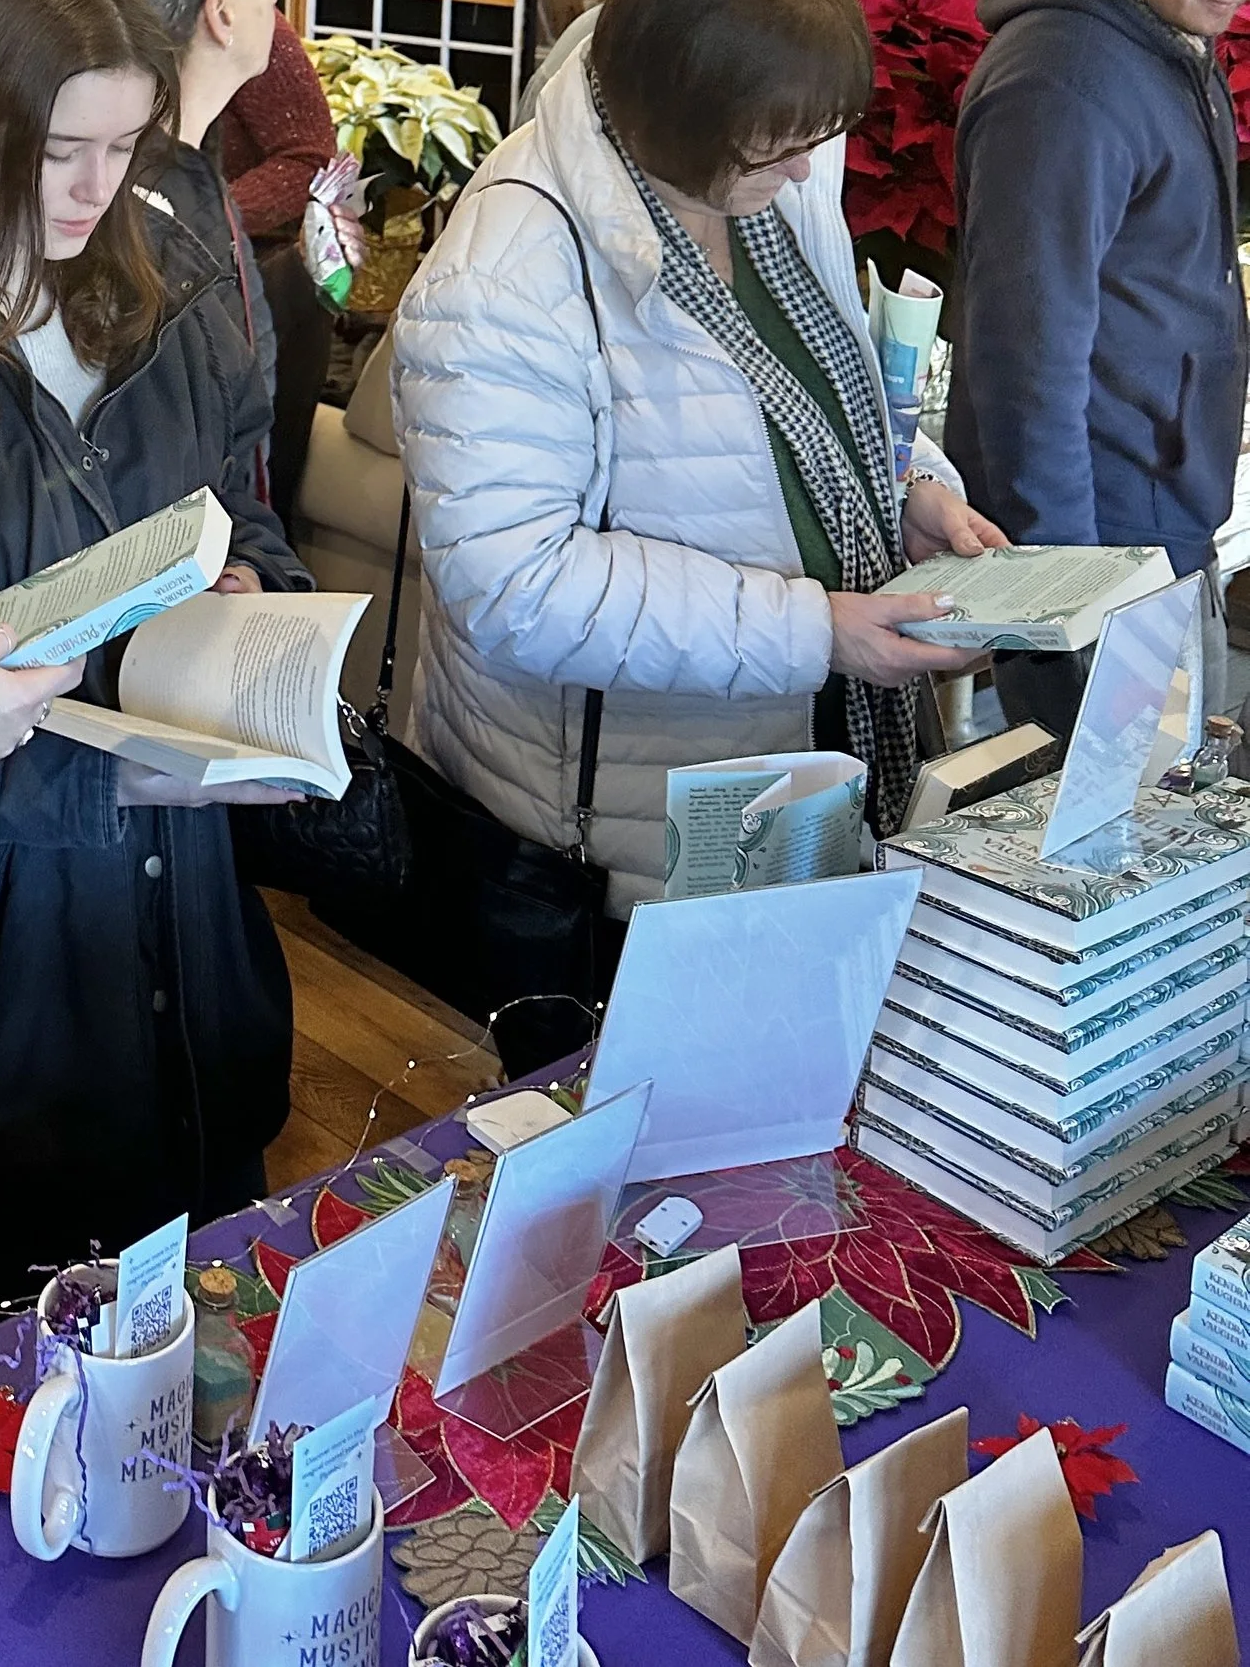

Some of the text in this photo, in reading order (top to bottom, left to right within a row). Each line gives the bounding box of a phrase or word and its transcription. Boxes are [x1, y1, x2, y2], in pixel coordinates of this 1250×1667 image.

[1209, 1271, 1249, 1301] KENDRA
[1202, 1318, 1248, 1350] VAUGHAN
[1206, 1309, 1246, 1338] KENDRA
[1186, 1351, 1236, 1387] VAUGHAN
[1192, 1343, 1234, 1375] KENDRA
[151, 1374, 191, 1421] MAGI
[141, 1403, 189, 1449] MYST
[311, 1582, 378, 1639] MAGIC
